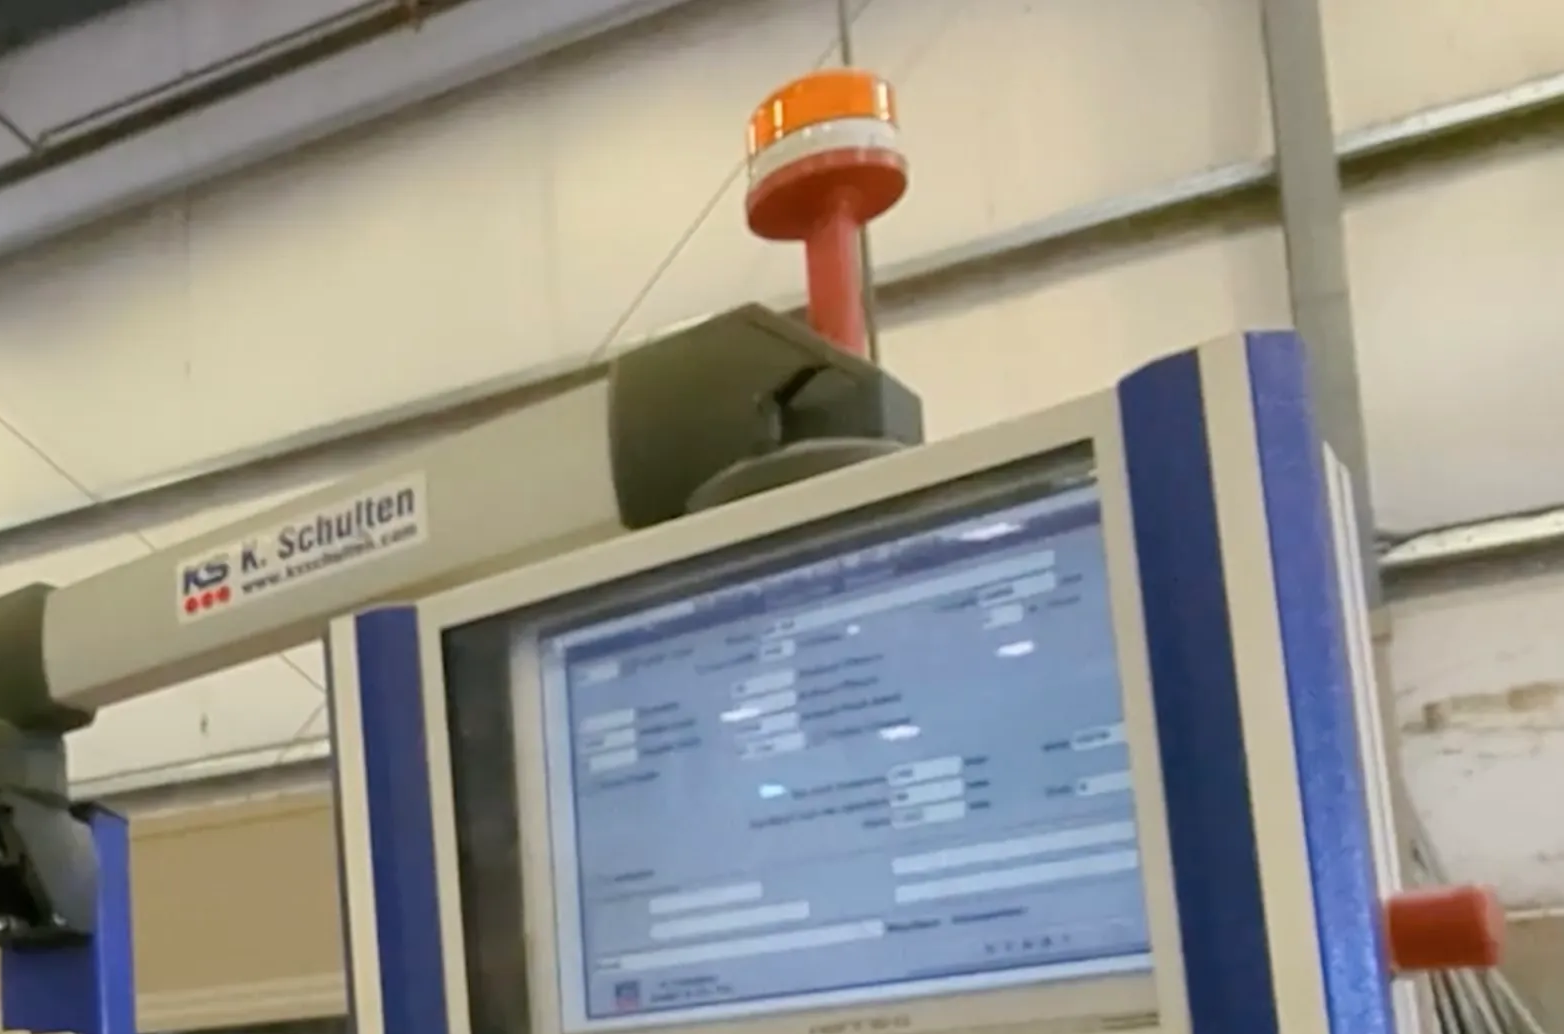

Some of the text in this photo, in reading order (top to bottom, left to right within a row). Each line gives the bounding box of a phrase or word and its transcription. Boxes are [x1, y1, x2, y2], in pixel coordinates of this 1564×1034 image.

[241, 487, 414, 574] K. Schulten
[182, 554, 230, 596] KS
